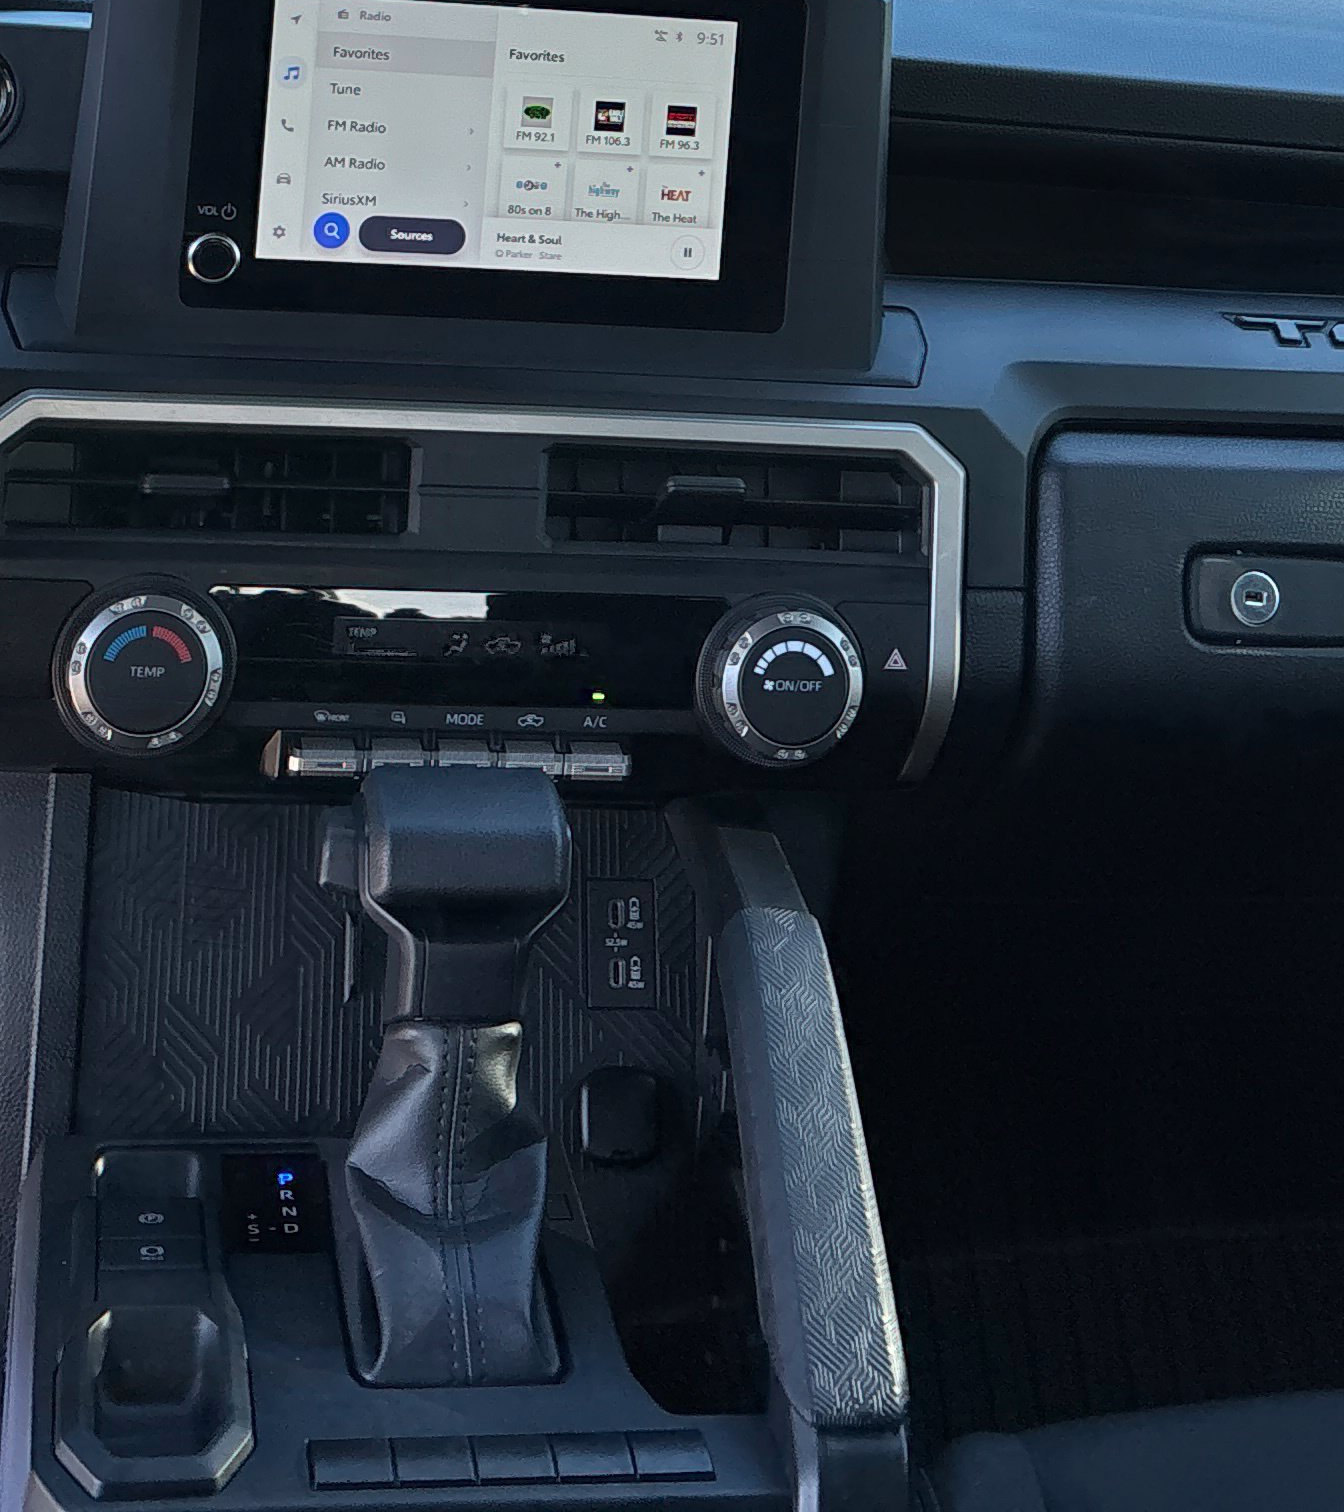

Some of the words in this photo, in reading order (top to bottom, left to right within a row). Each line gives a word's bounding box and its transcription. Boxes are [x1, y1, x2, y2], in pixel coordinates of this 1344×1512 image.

[359, 10, 392, 23] Radio
[697, 32, 725, 46] 9:51
[333, 46, 390, 61] Favorites
[509, 48, 565, 63] Favorites
[329, 82, 362, 96] Tune
[327, 119, 347, 132] FM
[350, 120, 387, 134] Radio
[515, 130, 532, 141] FM
[534, 131, 555, 143] 92.1
[585, 134, 602, 145] FM
[604, 135, 631, 147] 106.3
[659, 138, 676, 150] FM
[678, 140, 700, 151] 96.3
[323, 156, 346, 169] AM
[349, 157, 386, 171] Radio
[321, 192, 377, 207] SiriusXM
[660, 189, 692, 202] HEAT
[197, 205, 218, 216] VOL
[507, 204, 527, 216] 80s
[528, 207, 543, 216] on
[544, 206, 552, 217] 8
[575, 207, 594, 219] The
[652, 211, 671, 223] The
[673, 213, 697, 224] Heat
[390, 228, 434, 242] Sources
[496, 232, 527, 244] Heart
[528, 234, 537, 244] &
[538, 234, 563, 246] Soul
[130, 665, 166, 678] TEMP
[775, 679, 823, 692] ON/OFF
[445, 712, 486, 727] MODE
[582, 715, 608, 729] A/C
[277, 1172, 294, 1186] P
[279, 1189, 295, 1201] R
[281, 1206, 298, 1217] N
[247, 1223, 260, 1235] S
[283, 1223, 299, 1234] D
